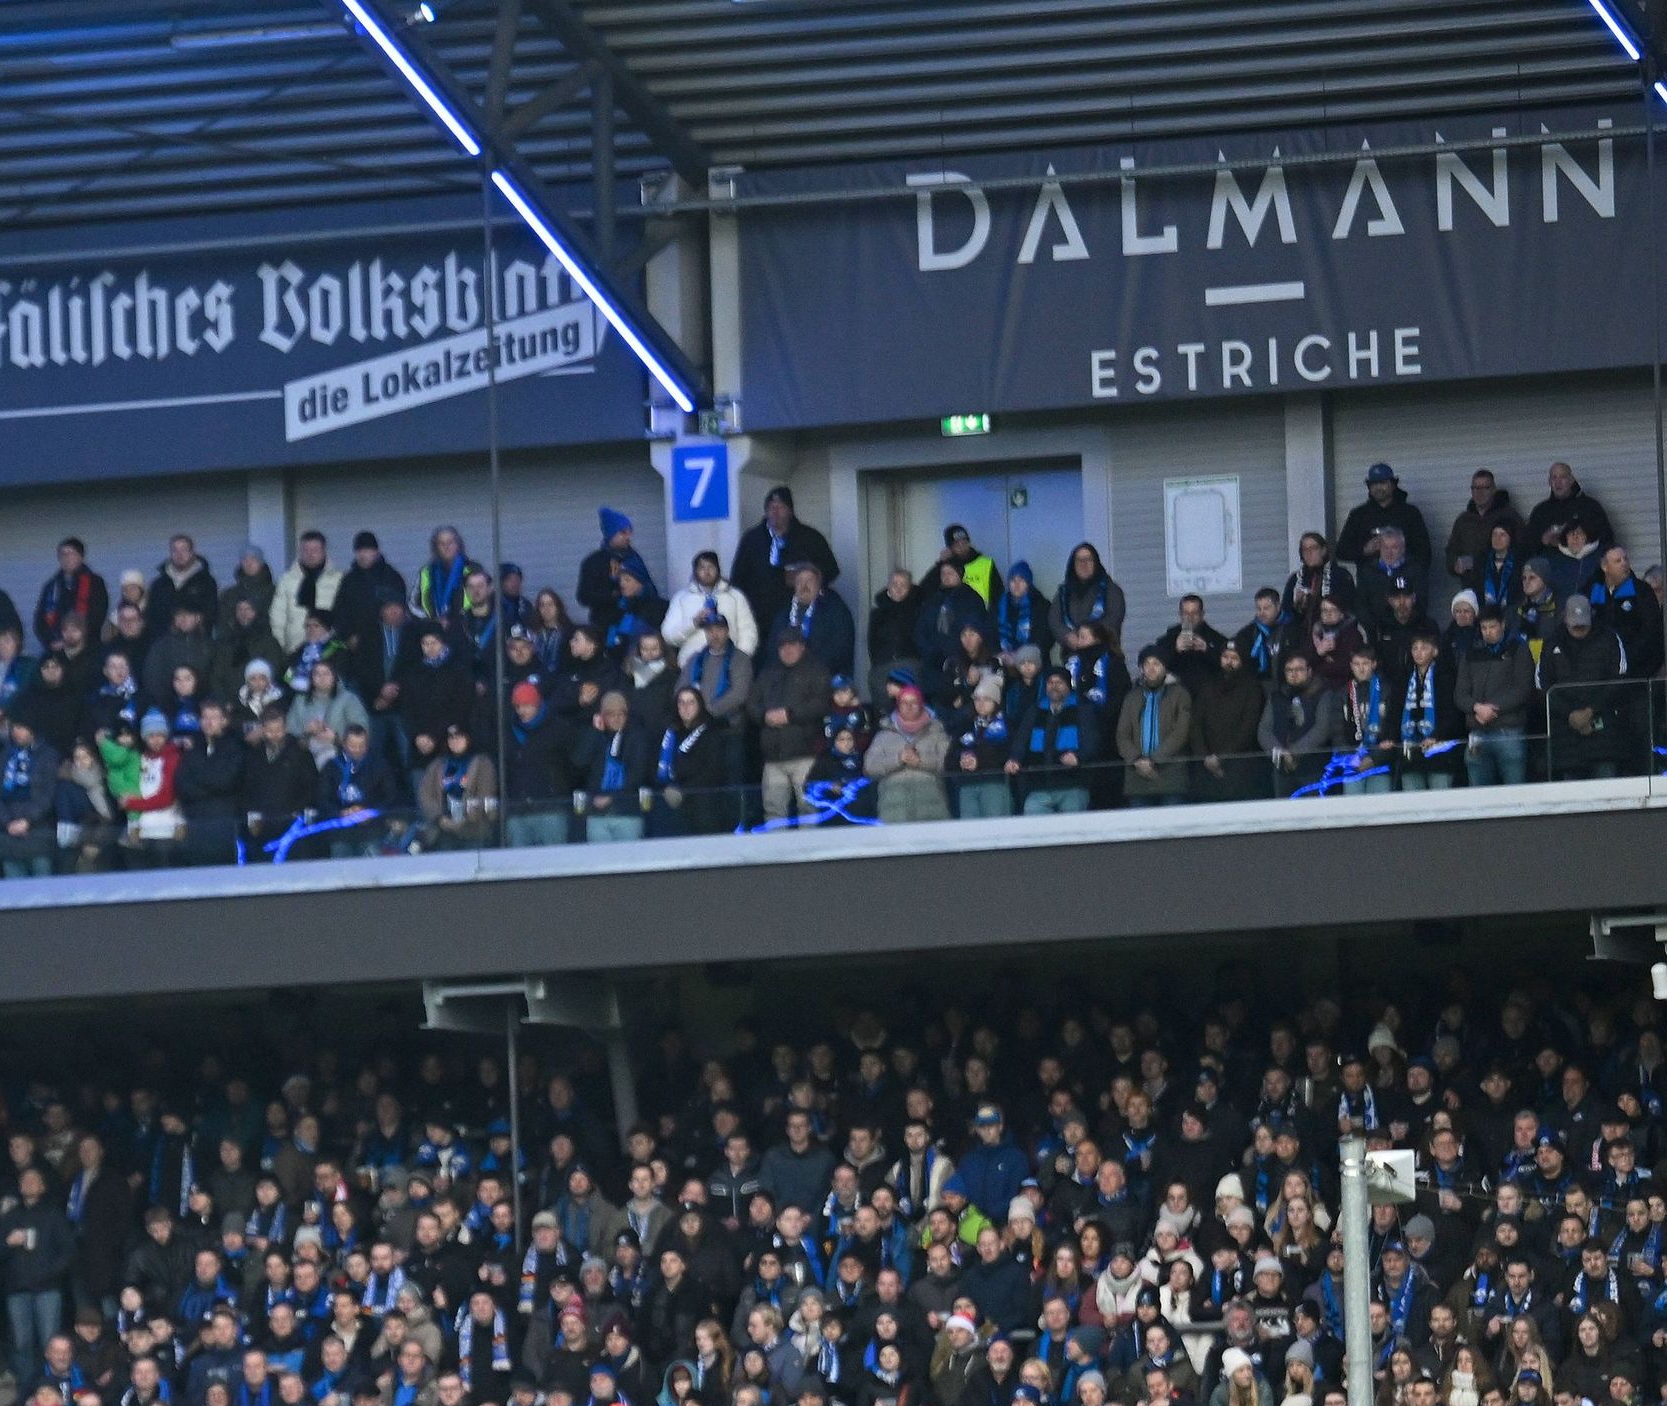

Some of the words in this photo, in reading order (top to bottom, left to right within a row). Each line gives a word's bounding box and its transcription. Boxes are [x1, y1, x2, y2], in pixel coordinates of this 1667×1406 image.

[905, 118, 1616, 272] DALMANN
[298, 384, 349, 425] die
[361, 319, 580, 404] Lokalzeitung
[1091, 327, 1422, 399] ESTRICHE
[684, 458, 715, 508] 7
